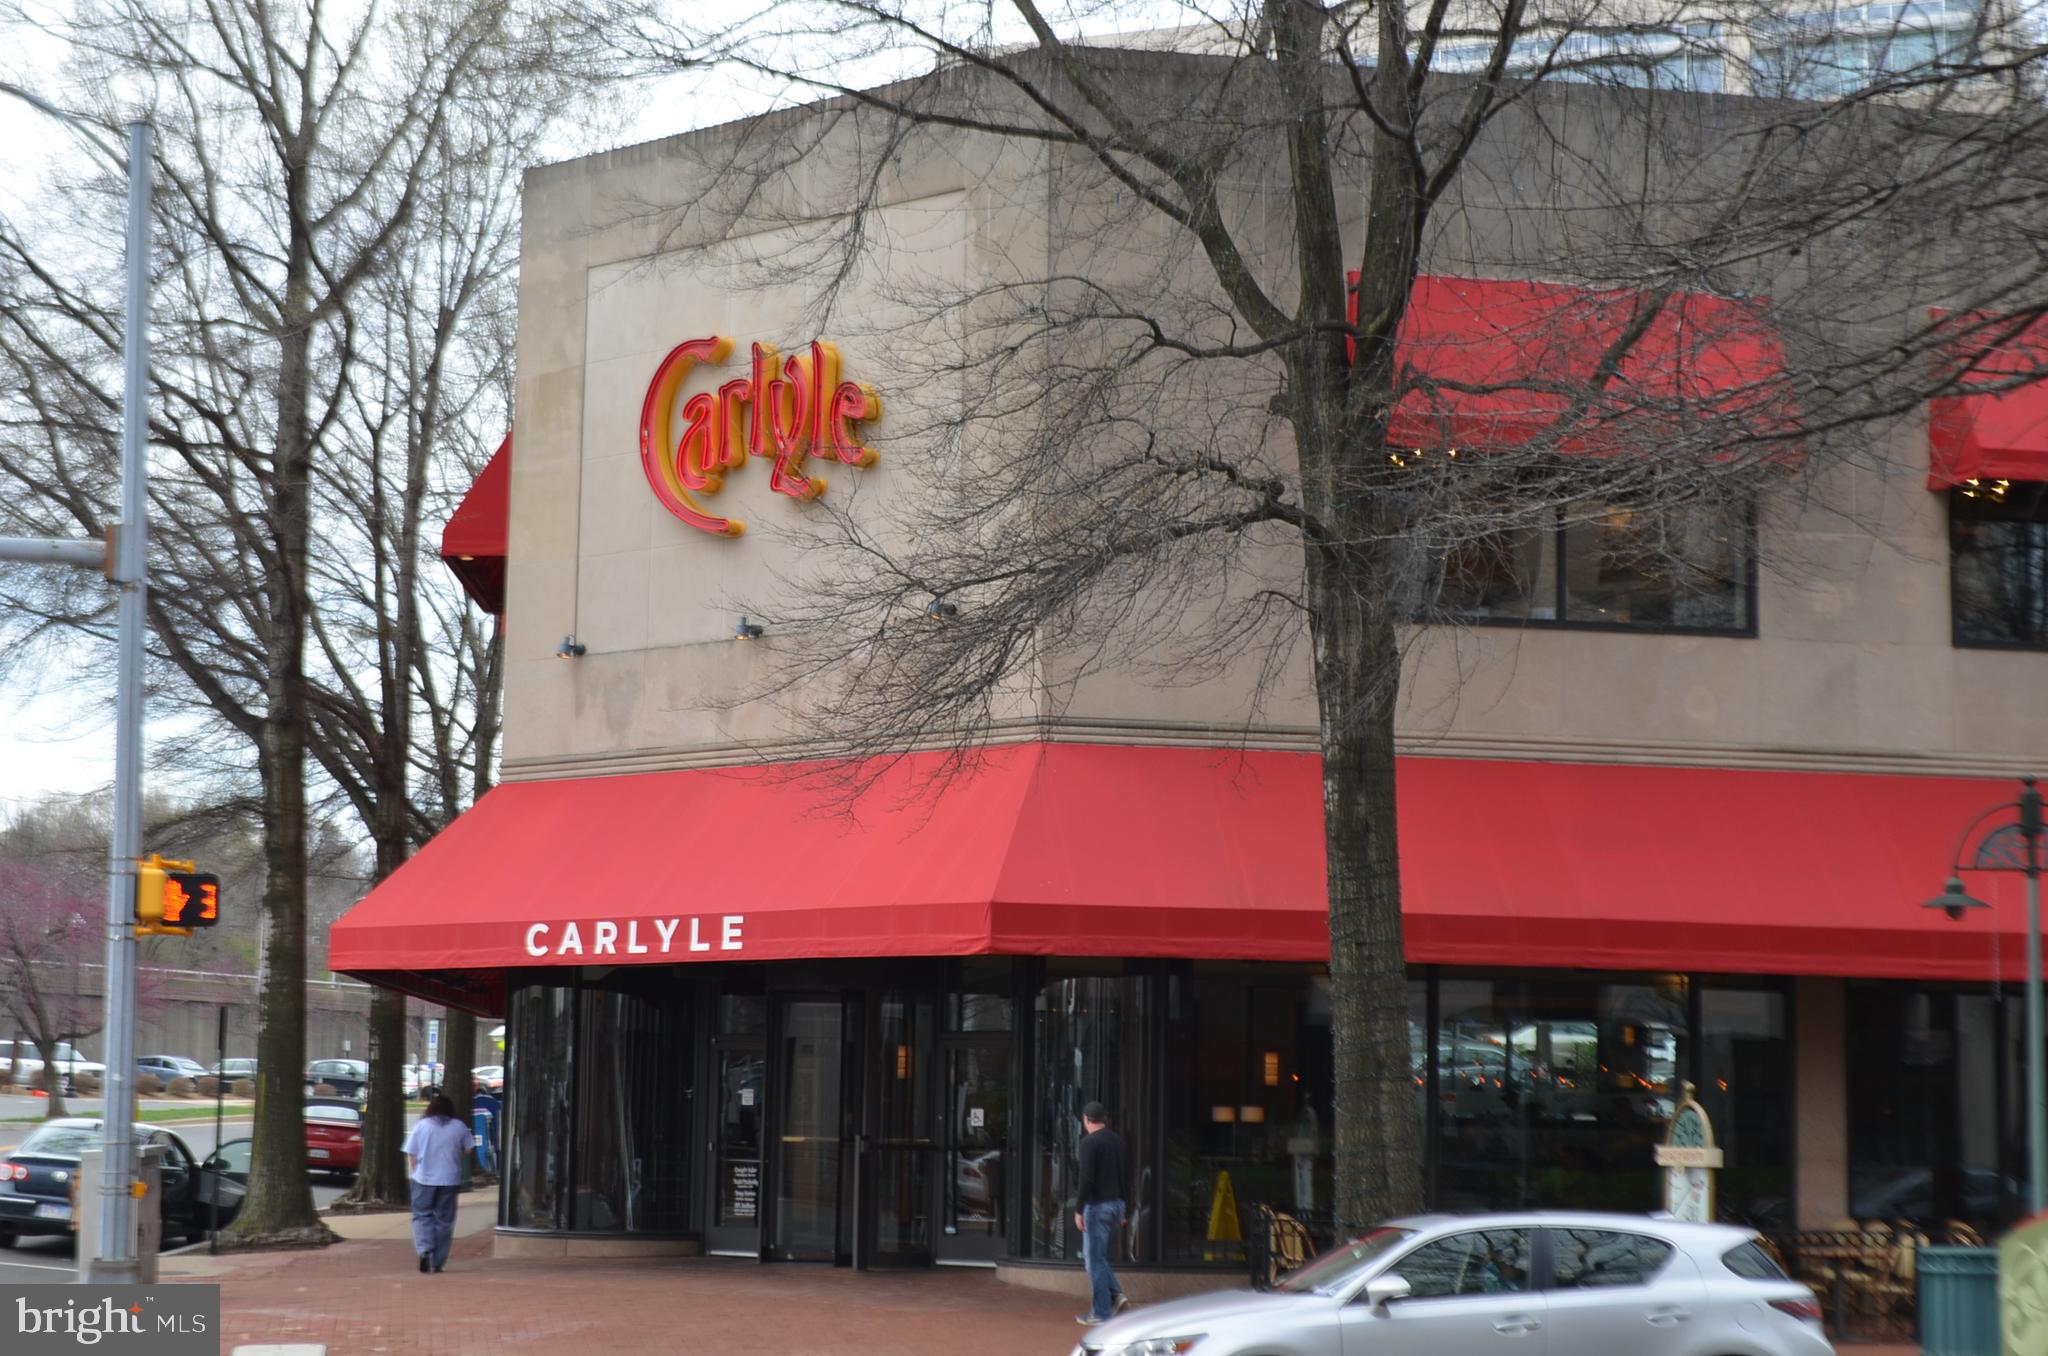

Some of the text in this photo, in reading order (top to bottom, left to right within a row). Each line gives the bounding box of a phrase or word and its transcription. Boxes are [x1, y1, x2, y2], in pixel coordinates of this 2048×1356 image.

[640, 336, 882, 537] Carlyle
[200, 884, 217, 919] 3
[526, 916, 744, 957] CARLYLE
